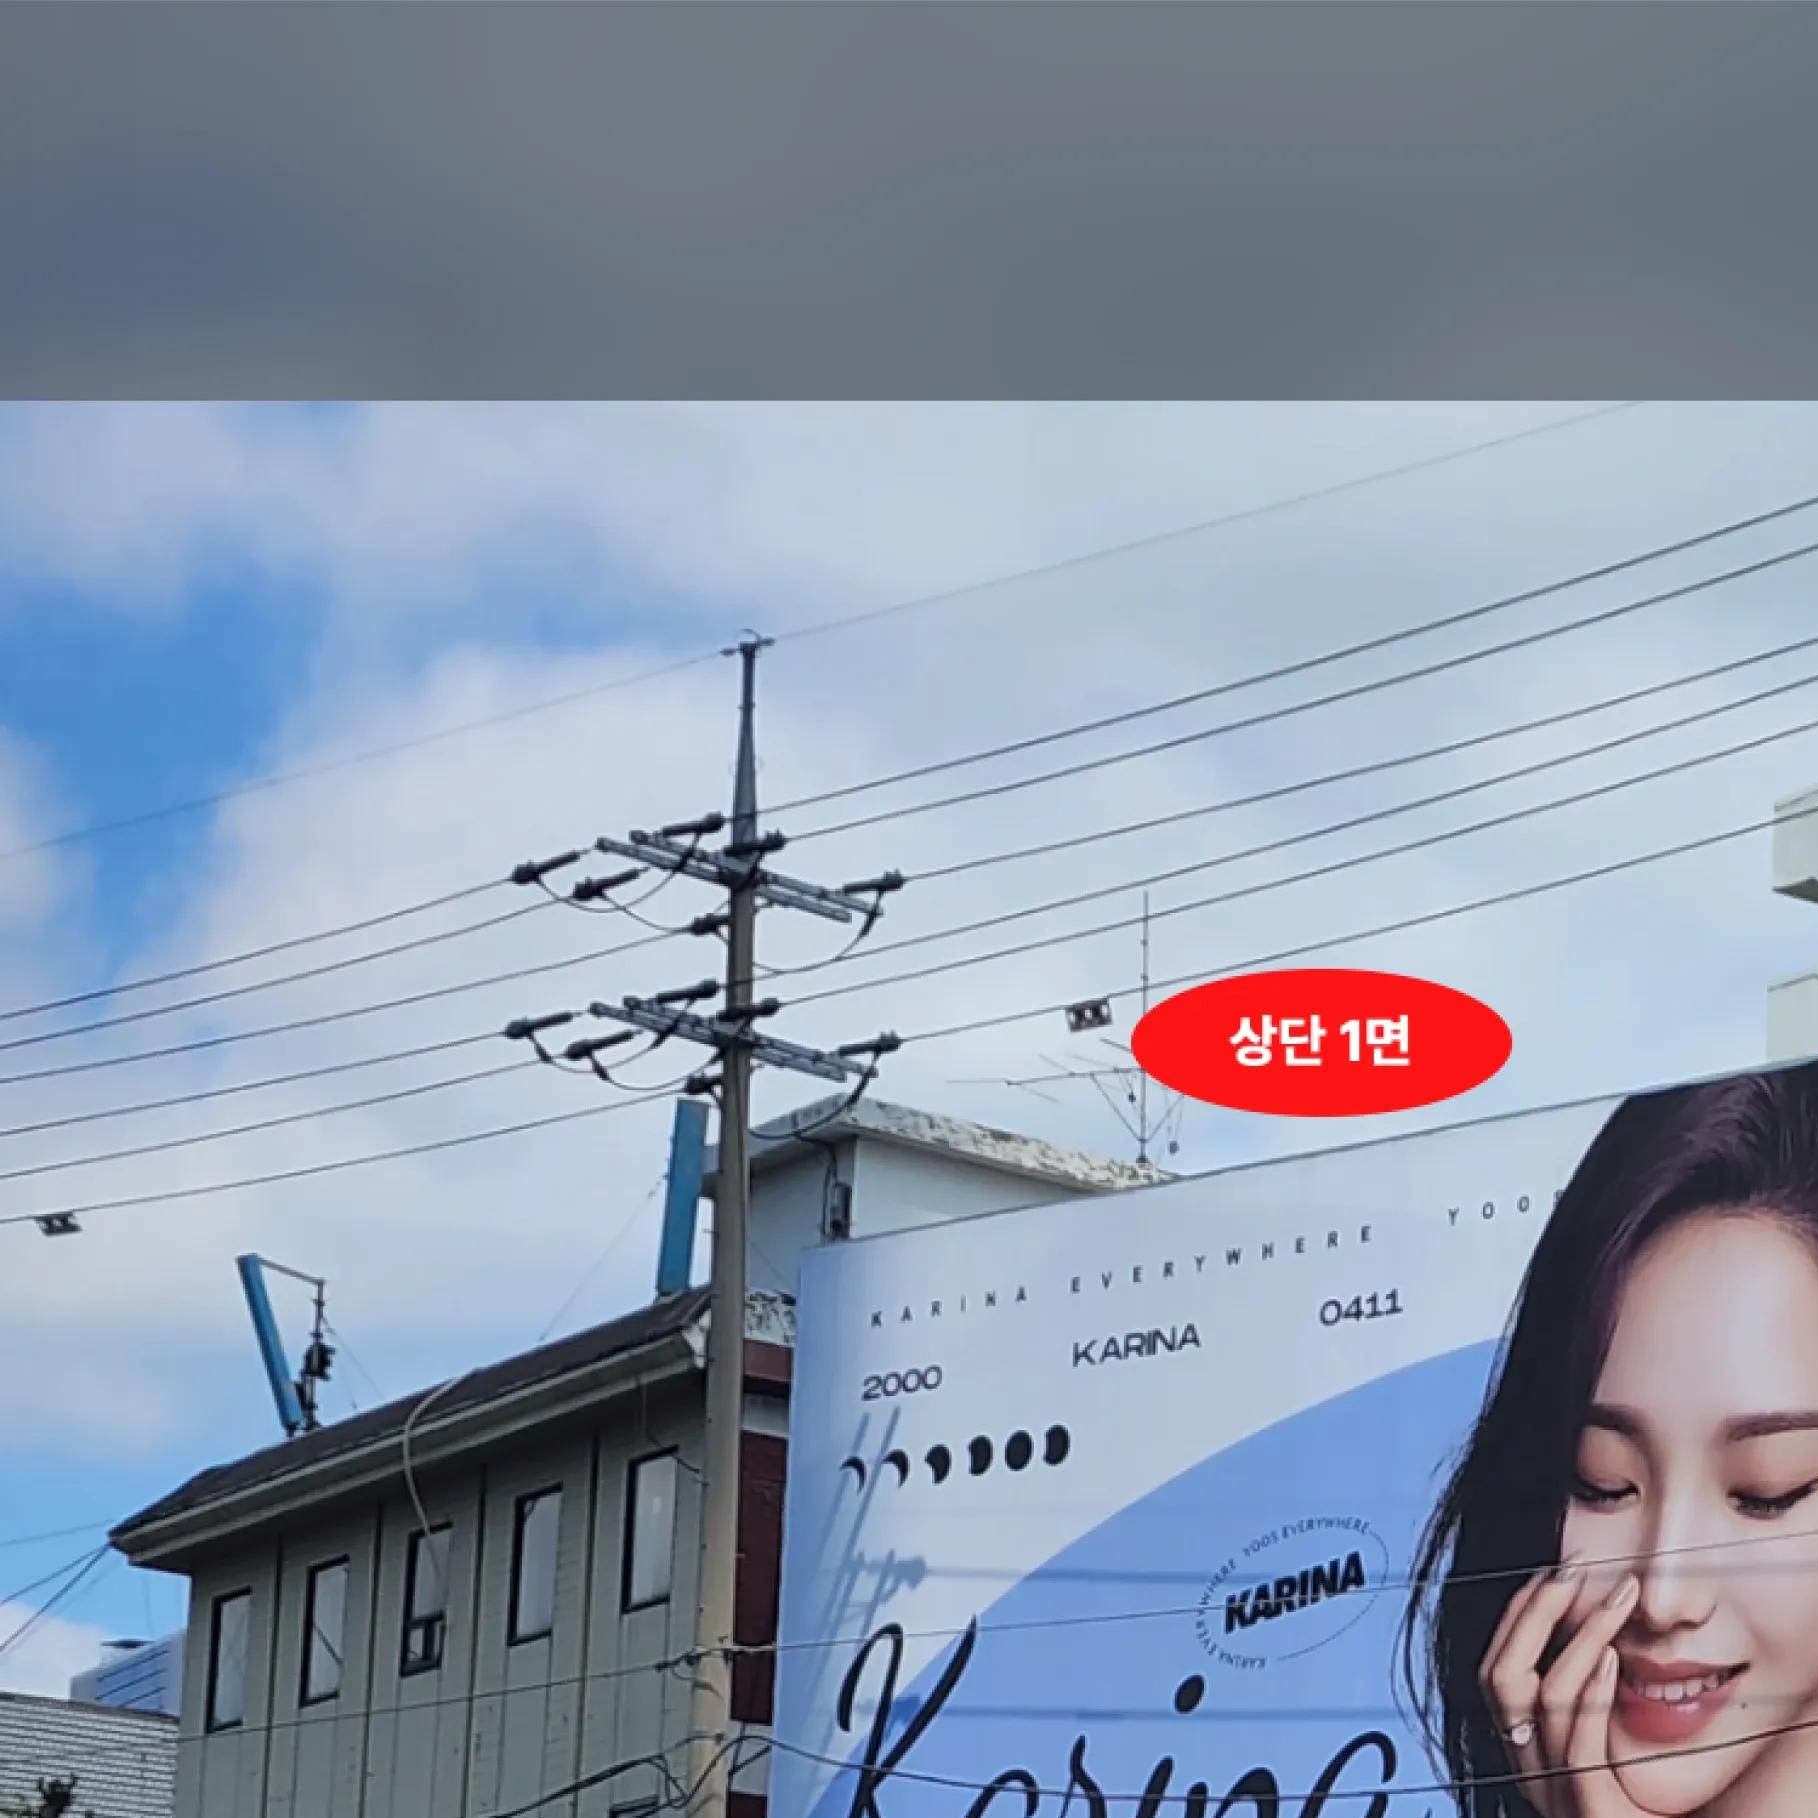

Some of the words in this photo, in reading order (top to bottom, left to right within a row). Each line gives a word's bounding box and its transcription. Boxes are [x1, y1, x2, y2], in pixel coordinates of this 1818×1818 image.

[871, 1285, 1027, 1328] KARINA
[1071, 1225, 1372, 1294] EVERYWHERE
[1319, 1288, 1404, 1326] 0411
[1072, 1323, 1202, 1368] KARINA
[861, 1364, 942, 1401] 2000
[1225, 1551, 1365, 1634] KARINA
